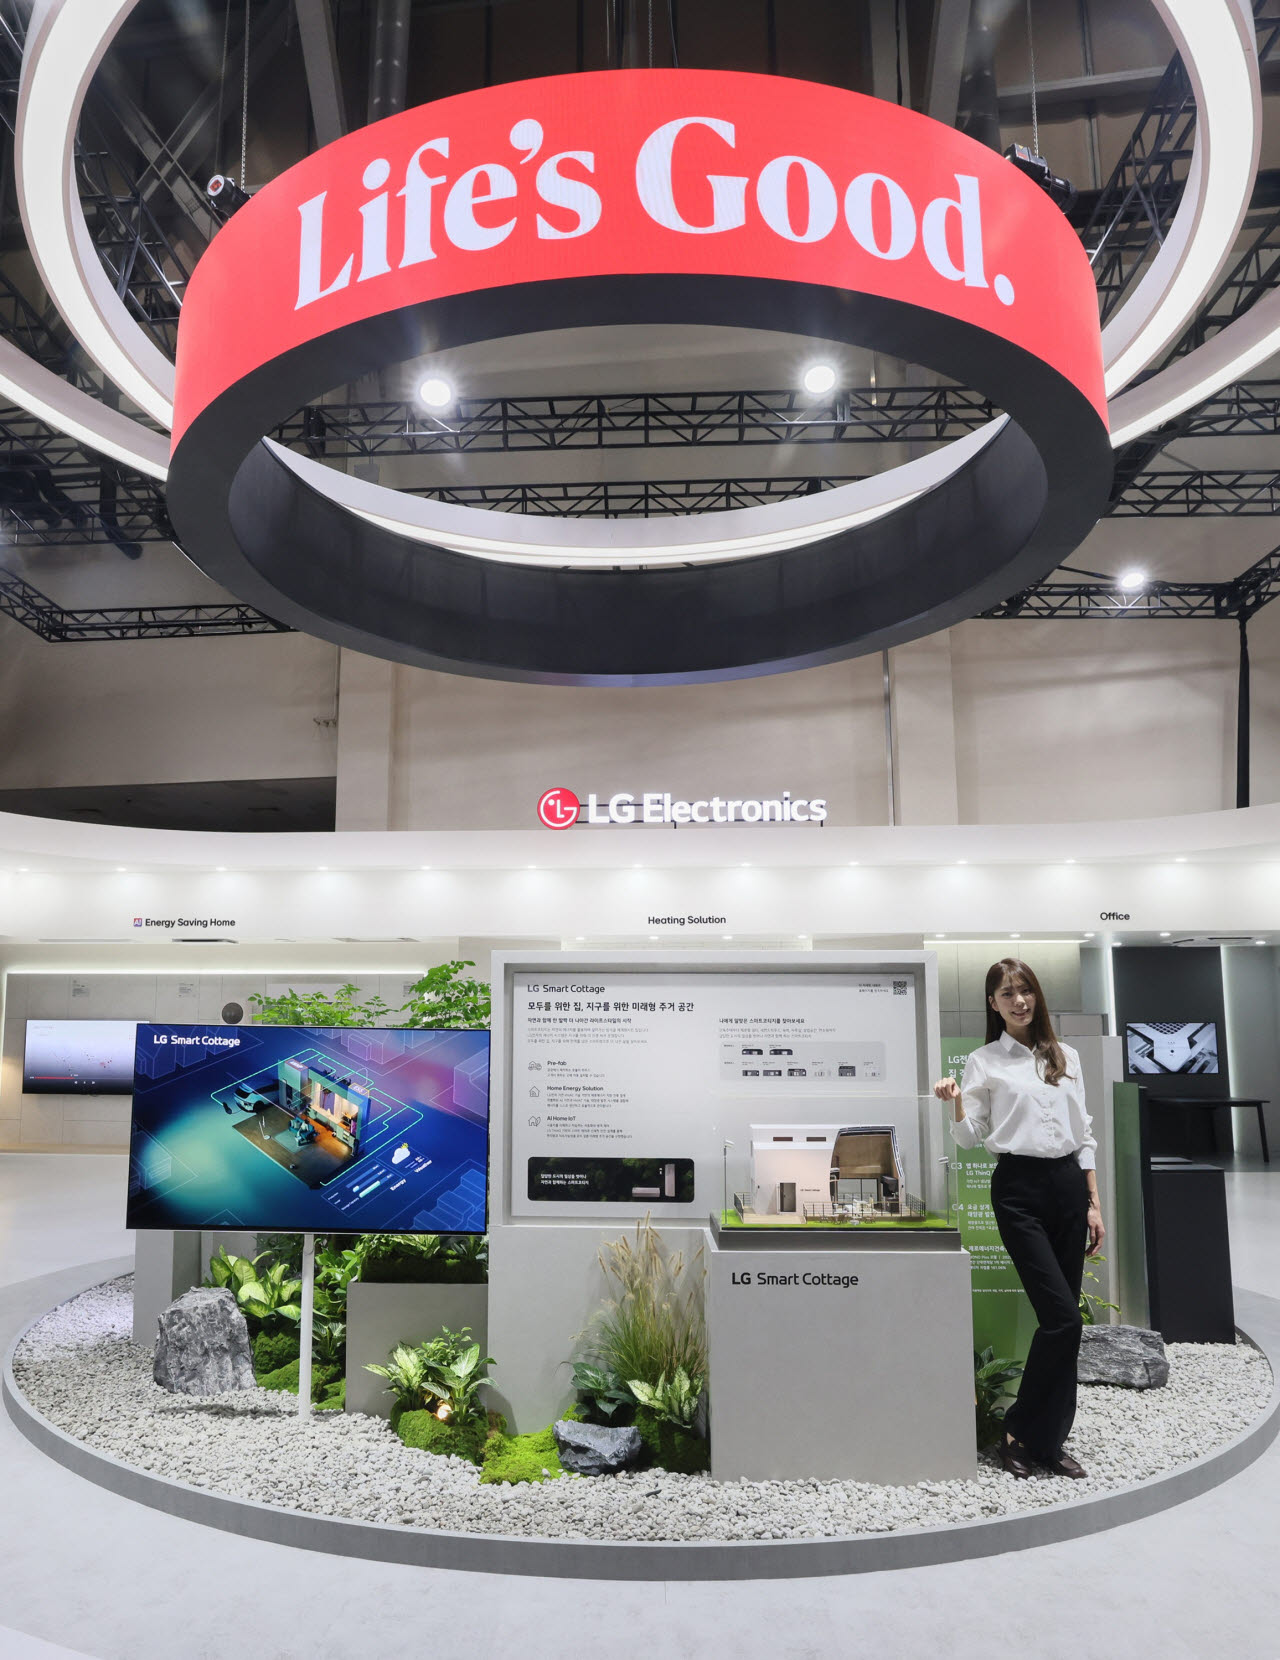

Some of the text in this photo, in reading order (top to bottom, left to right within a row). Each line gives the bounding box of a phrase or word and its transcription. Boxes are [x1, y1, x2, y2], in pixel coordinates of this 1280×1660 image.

[293, 116, 1017, 312] Life’s Good.
[588, 790, 828, 824] LG Electronics
[648, 914, 727, 926] Heating Solution
[1099, 911, 1131, 922] Office
[145, 918, 176, 929] Energy
[177, 918, 208, 929] Saving
[210, 918, 236, 927] Home
[527, 984, 606, 995] LG Smart Cottage
[527, 1001, 694, 1012] 모두를 위한 집, 지구를 위한 미래형 주거 공간
[153, 1034, 241, 1048] LG Smart Cottage
[948, 1055, 968, 1064] LG전
[731, 1271, 859, 1289] LG Smart Cottage
